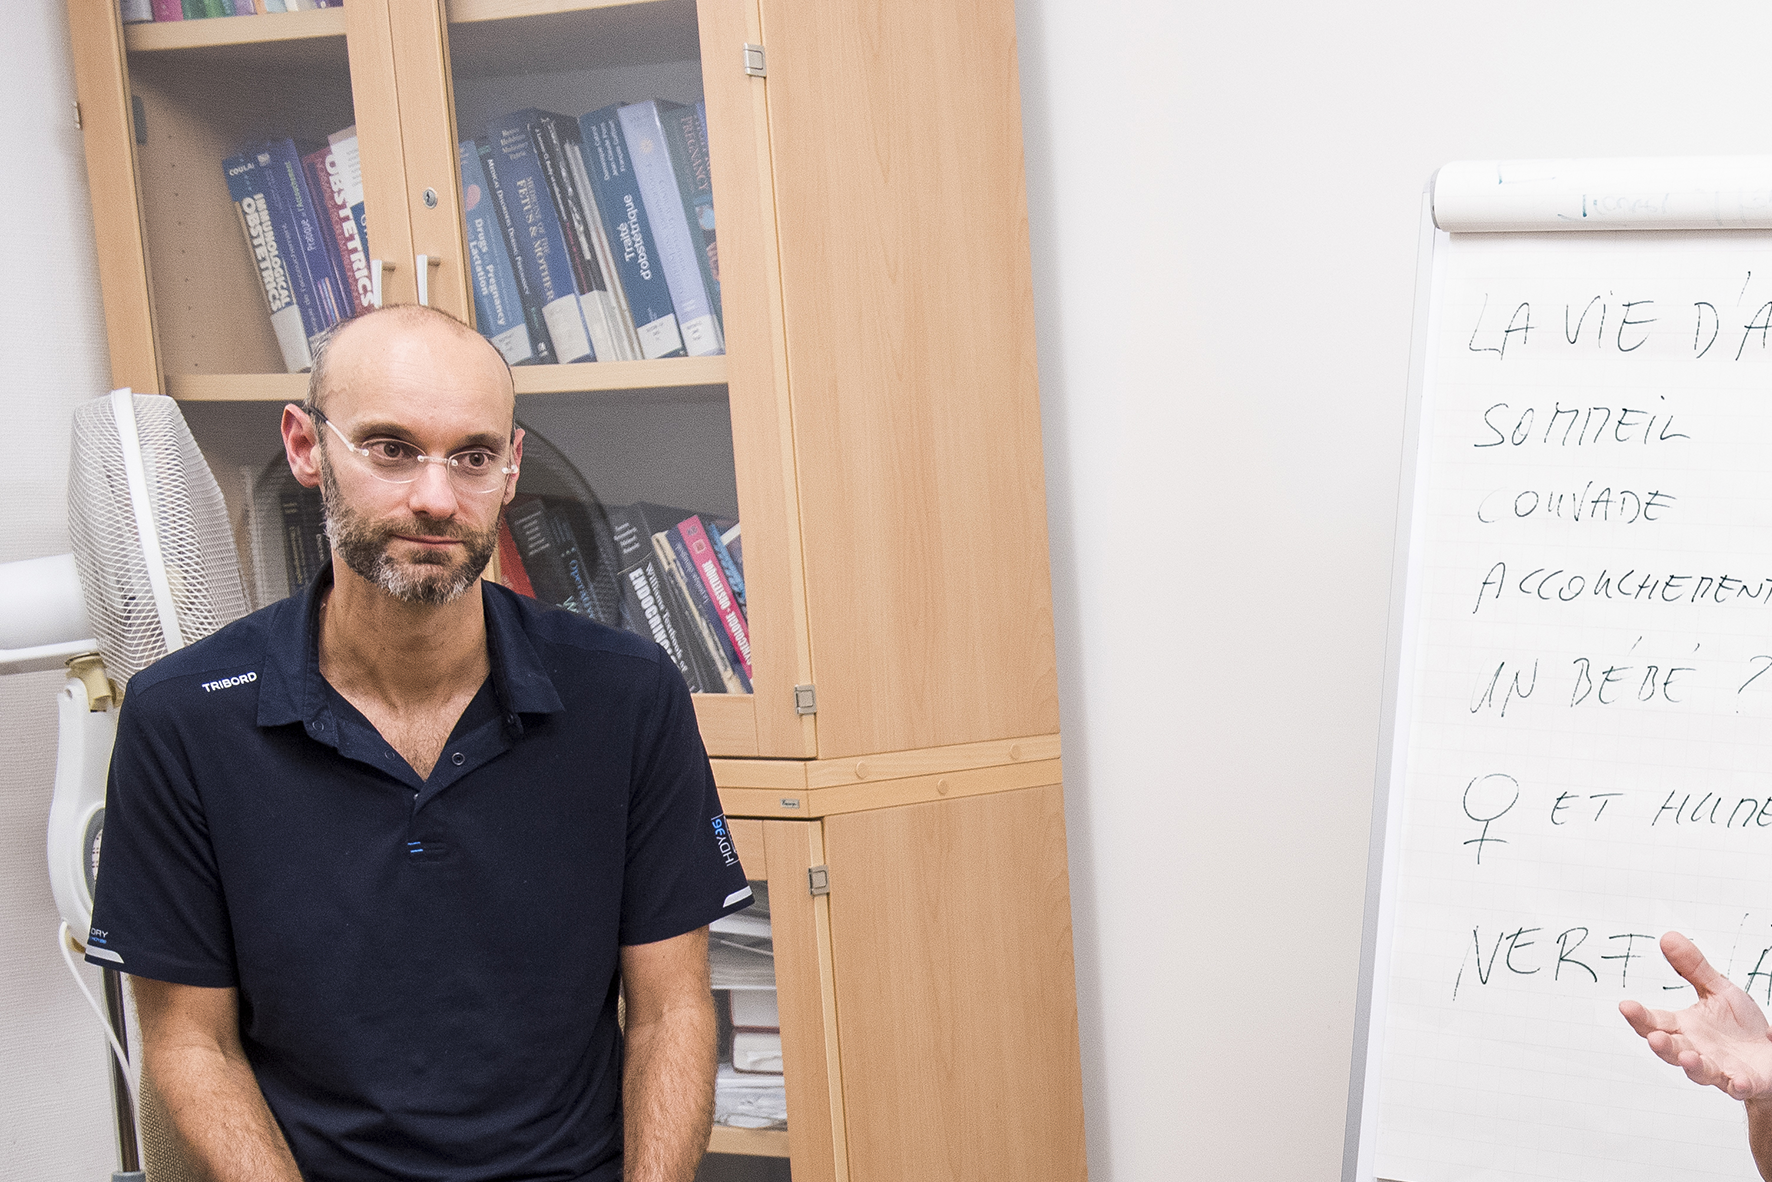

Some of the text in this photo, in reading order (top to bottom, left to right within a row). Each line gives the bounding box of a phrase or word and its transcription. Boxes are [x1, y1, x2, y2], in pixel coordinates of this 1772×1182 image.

[241, 196, 281, 312] OBSTETRICS
[253, 192, 292, 305] IMMUNOLOGICAL
[325, 154, 374, 307] OBSTETRICS
[468, 240, 489, 295] Lactation
[473, 217, 490, 253] Drugs
[485, 263, 507, 326] Pregnancy
[616, 221, 636, 262] Traité
[623, 194, 652, 281] d'obstétrique
[1469, 293, 1538, 360] LA
[643, 561, 667, 611] Williams
[661, 608, 684, 660] Textbook
[201, 671, 258, 693] TRIBORD
[1551, 790, 1625, 827] ET
